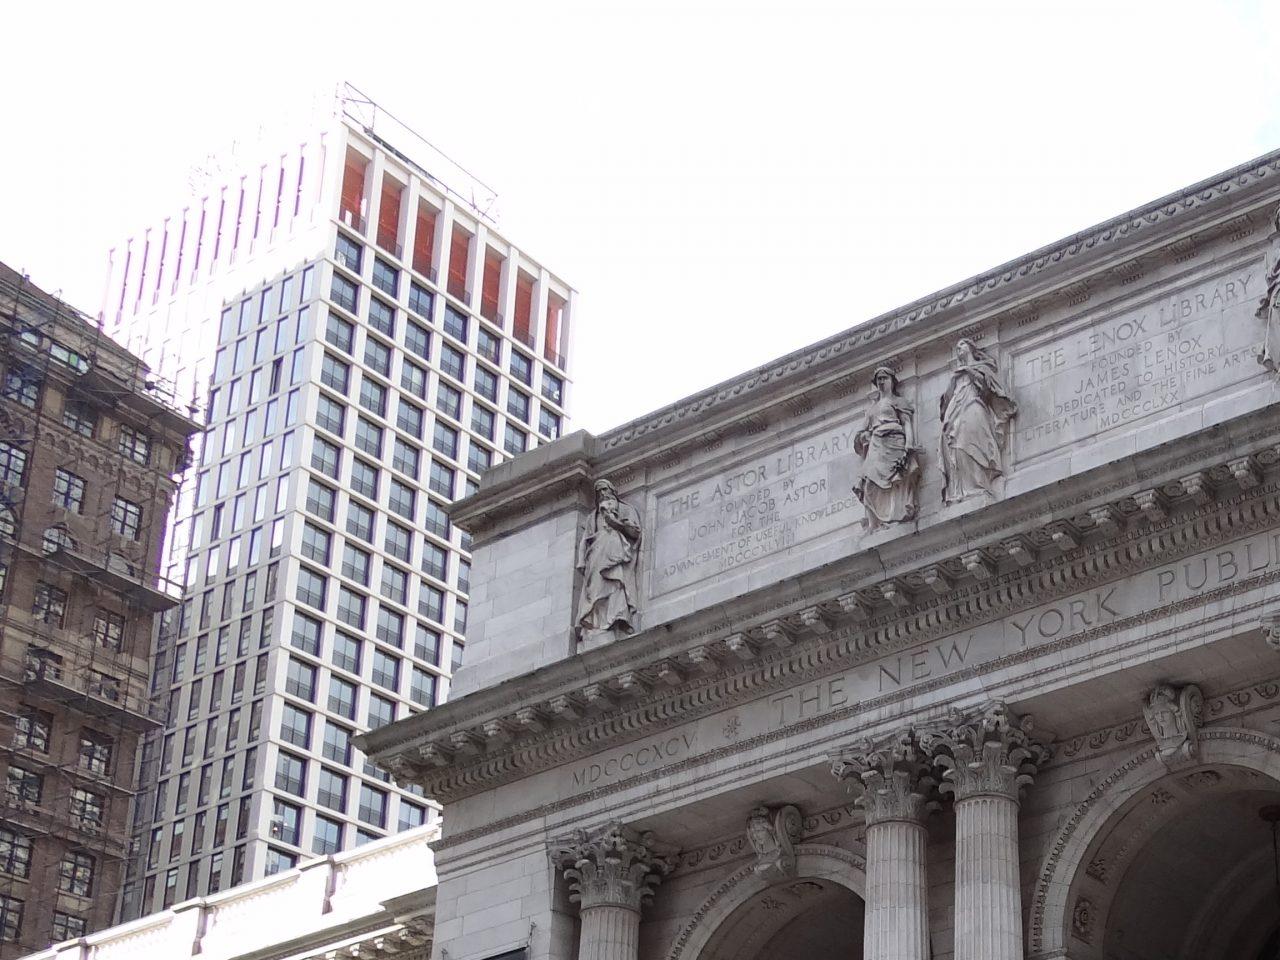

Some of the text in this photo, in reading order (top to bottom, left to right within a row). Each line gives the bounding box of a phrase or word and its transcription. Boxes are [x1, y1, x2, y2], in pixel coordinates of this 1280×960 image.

[1026, 273, 1254, 379] THE LENOX LIBRARY
[1091, 328, 1182, 372] FOUNDED BY
[1023, 346, 1258, 438] LITERATURE AND THE FINE ARTS
[1052, 344, 1225, 417] DEDICATED TO HISTORY
[1075, 335, 1203, 394] JAMES LENOX
[1100, 389, 1180, 429] MDCCCLXX
[669, 431, 854, 518] THE ASTOR LIBRARY
[720, 475, 795, 514] FOUNDED BY
[663, 497, 859, 577] ADVANCEMENT OF USEFUL KNOWLEDGE
[689, 478, 828, 541] JOHN JACOB ASTOR
[731, 511, 781, 538] FOR THE
[570, 731, 699, 790] MDCCCXCV
[772, 676, 849, 726] THE
[879, 634, 977, 692] NEW
[1012, 587, 1119, 646] YORK
